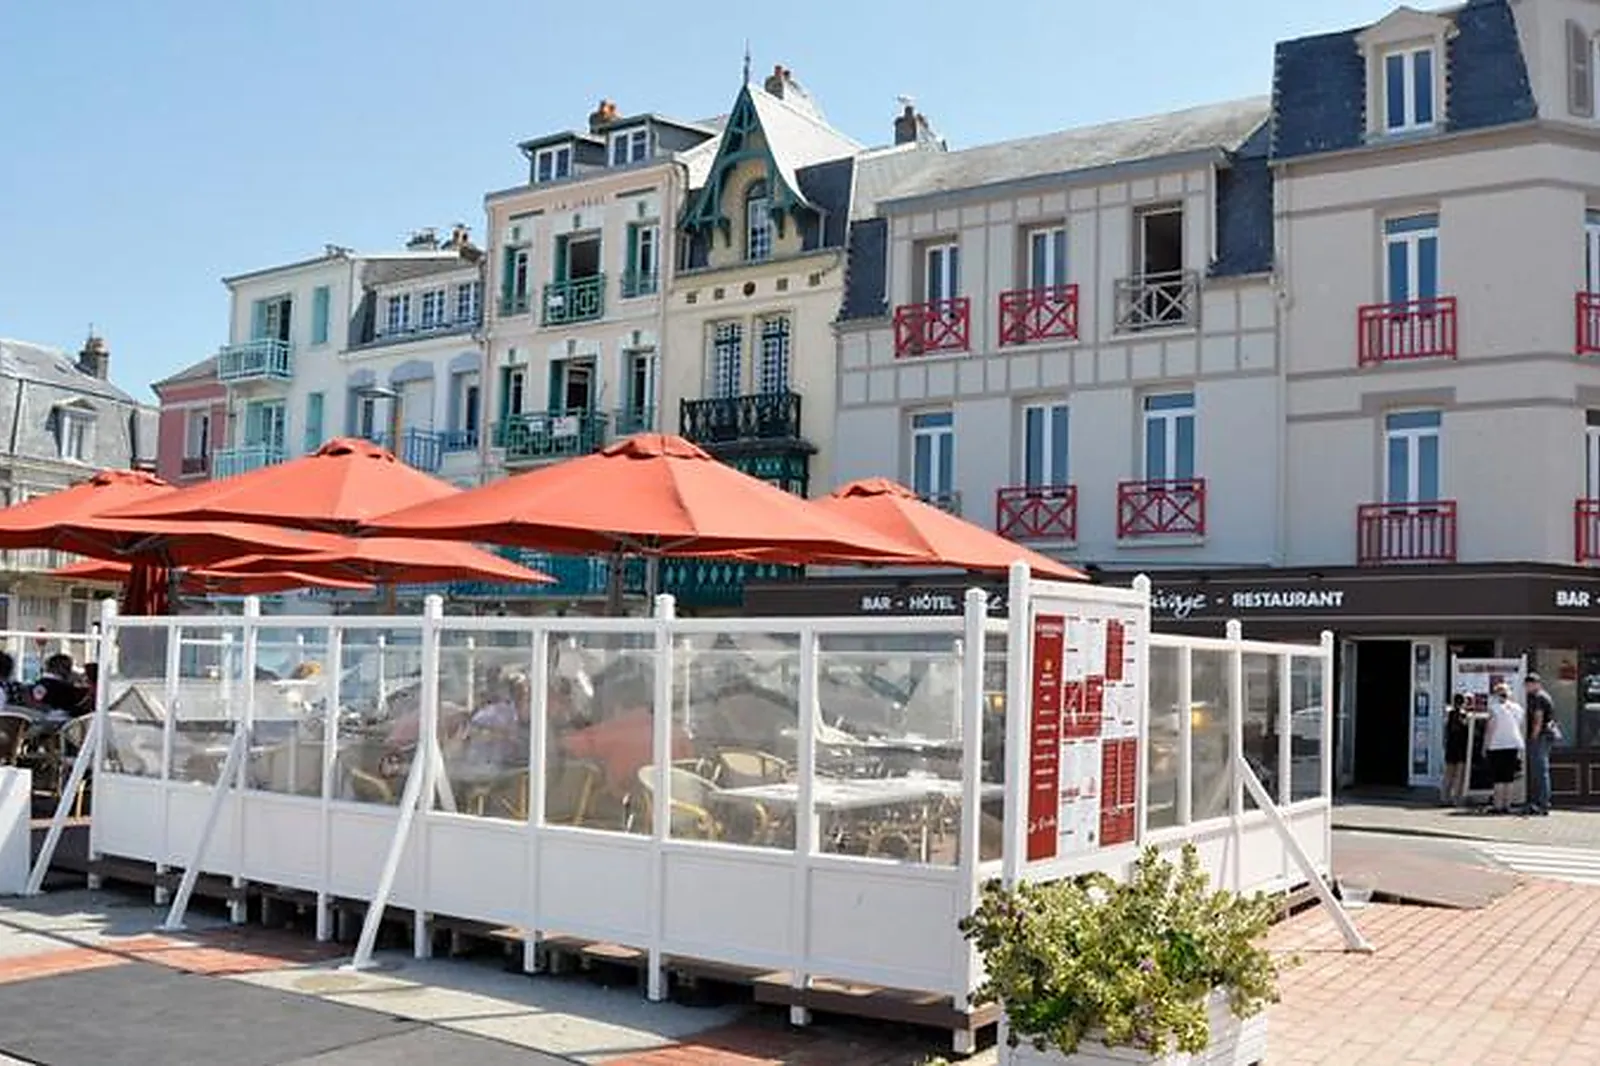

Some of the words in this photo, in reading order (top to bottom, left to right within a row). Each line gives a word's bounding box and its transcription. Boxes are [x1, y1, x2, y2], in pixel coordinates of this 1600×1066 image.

[861, 596, 890, 610] BAR
[909, 593, 956, 610] HÔTEL
[1232, 591, 1343, 607] RESTAURANT
[1556, 591, 1590, 607] BAR
